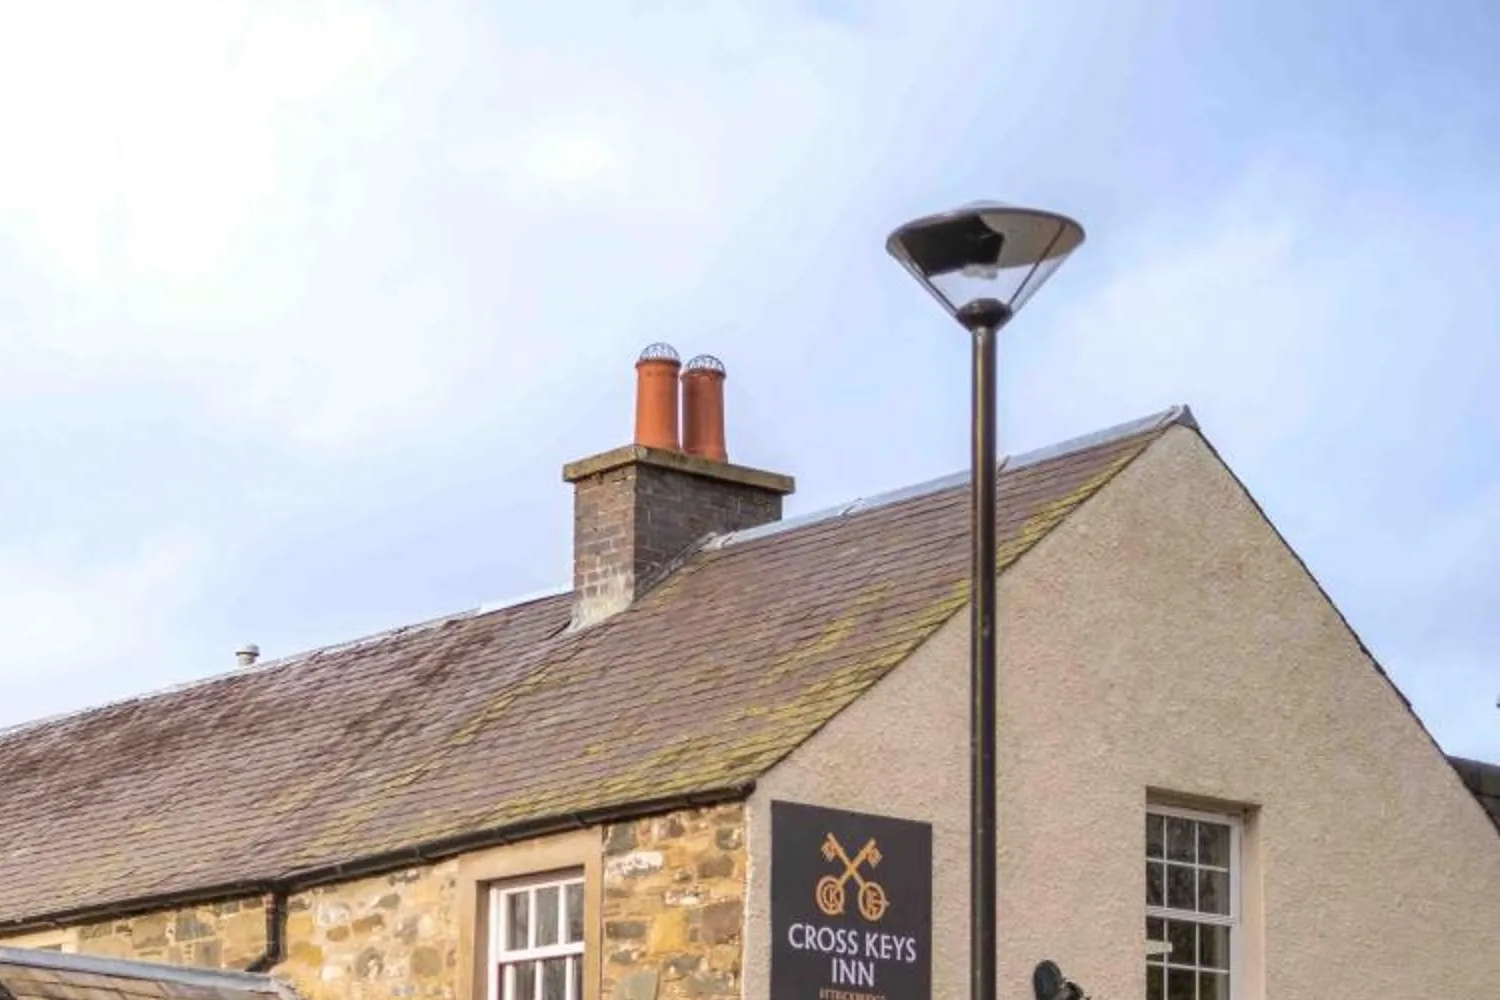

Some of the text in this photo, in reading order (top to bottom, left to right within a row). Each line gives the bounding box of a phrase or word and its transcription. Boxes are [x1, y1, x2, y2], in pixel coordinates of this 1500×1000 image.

[787, 923, 916, 963] CROSS KEYS
[831, 957, 875, 987] INN
